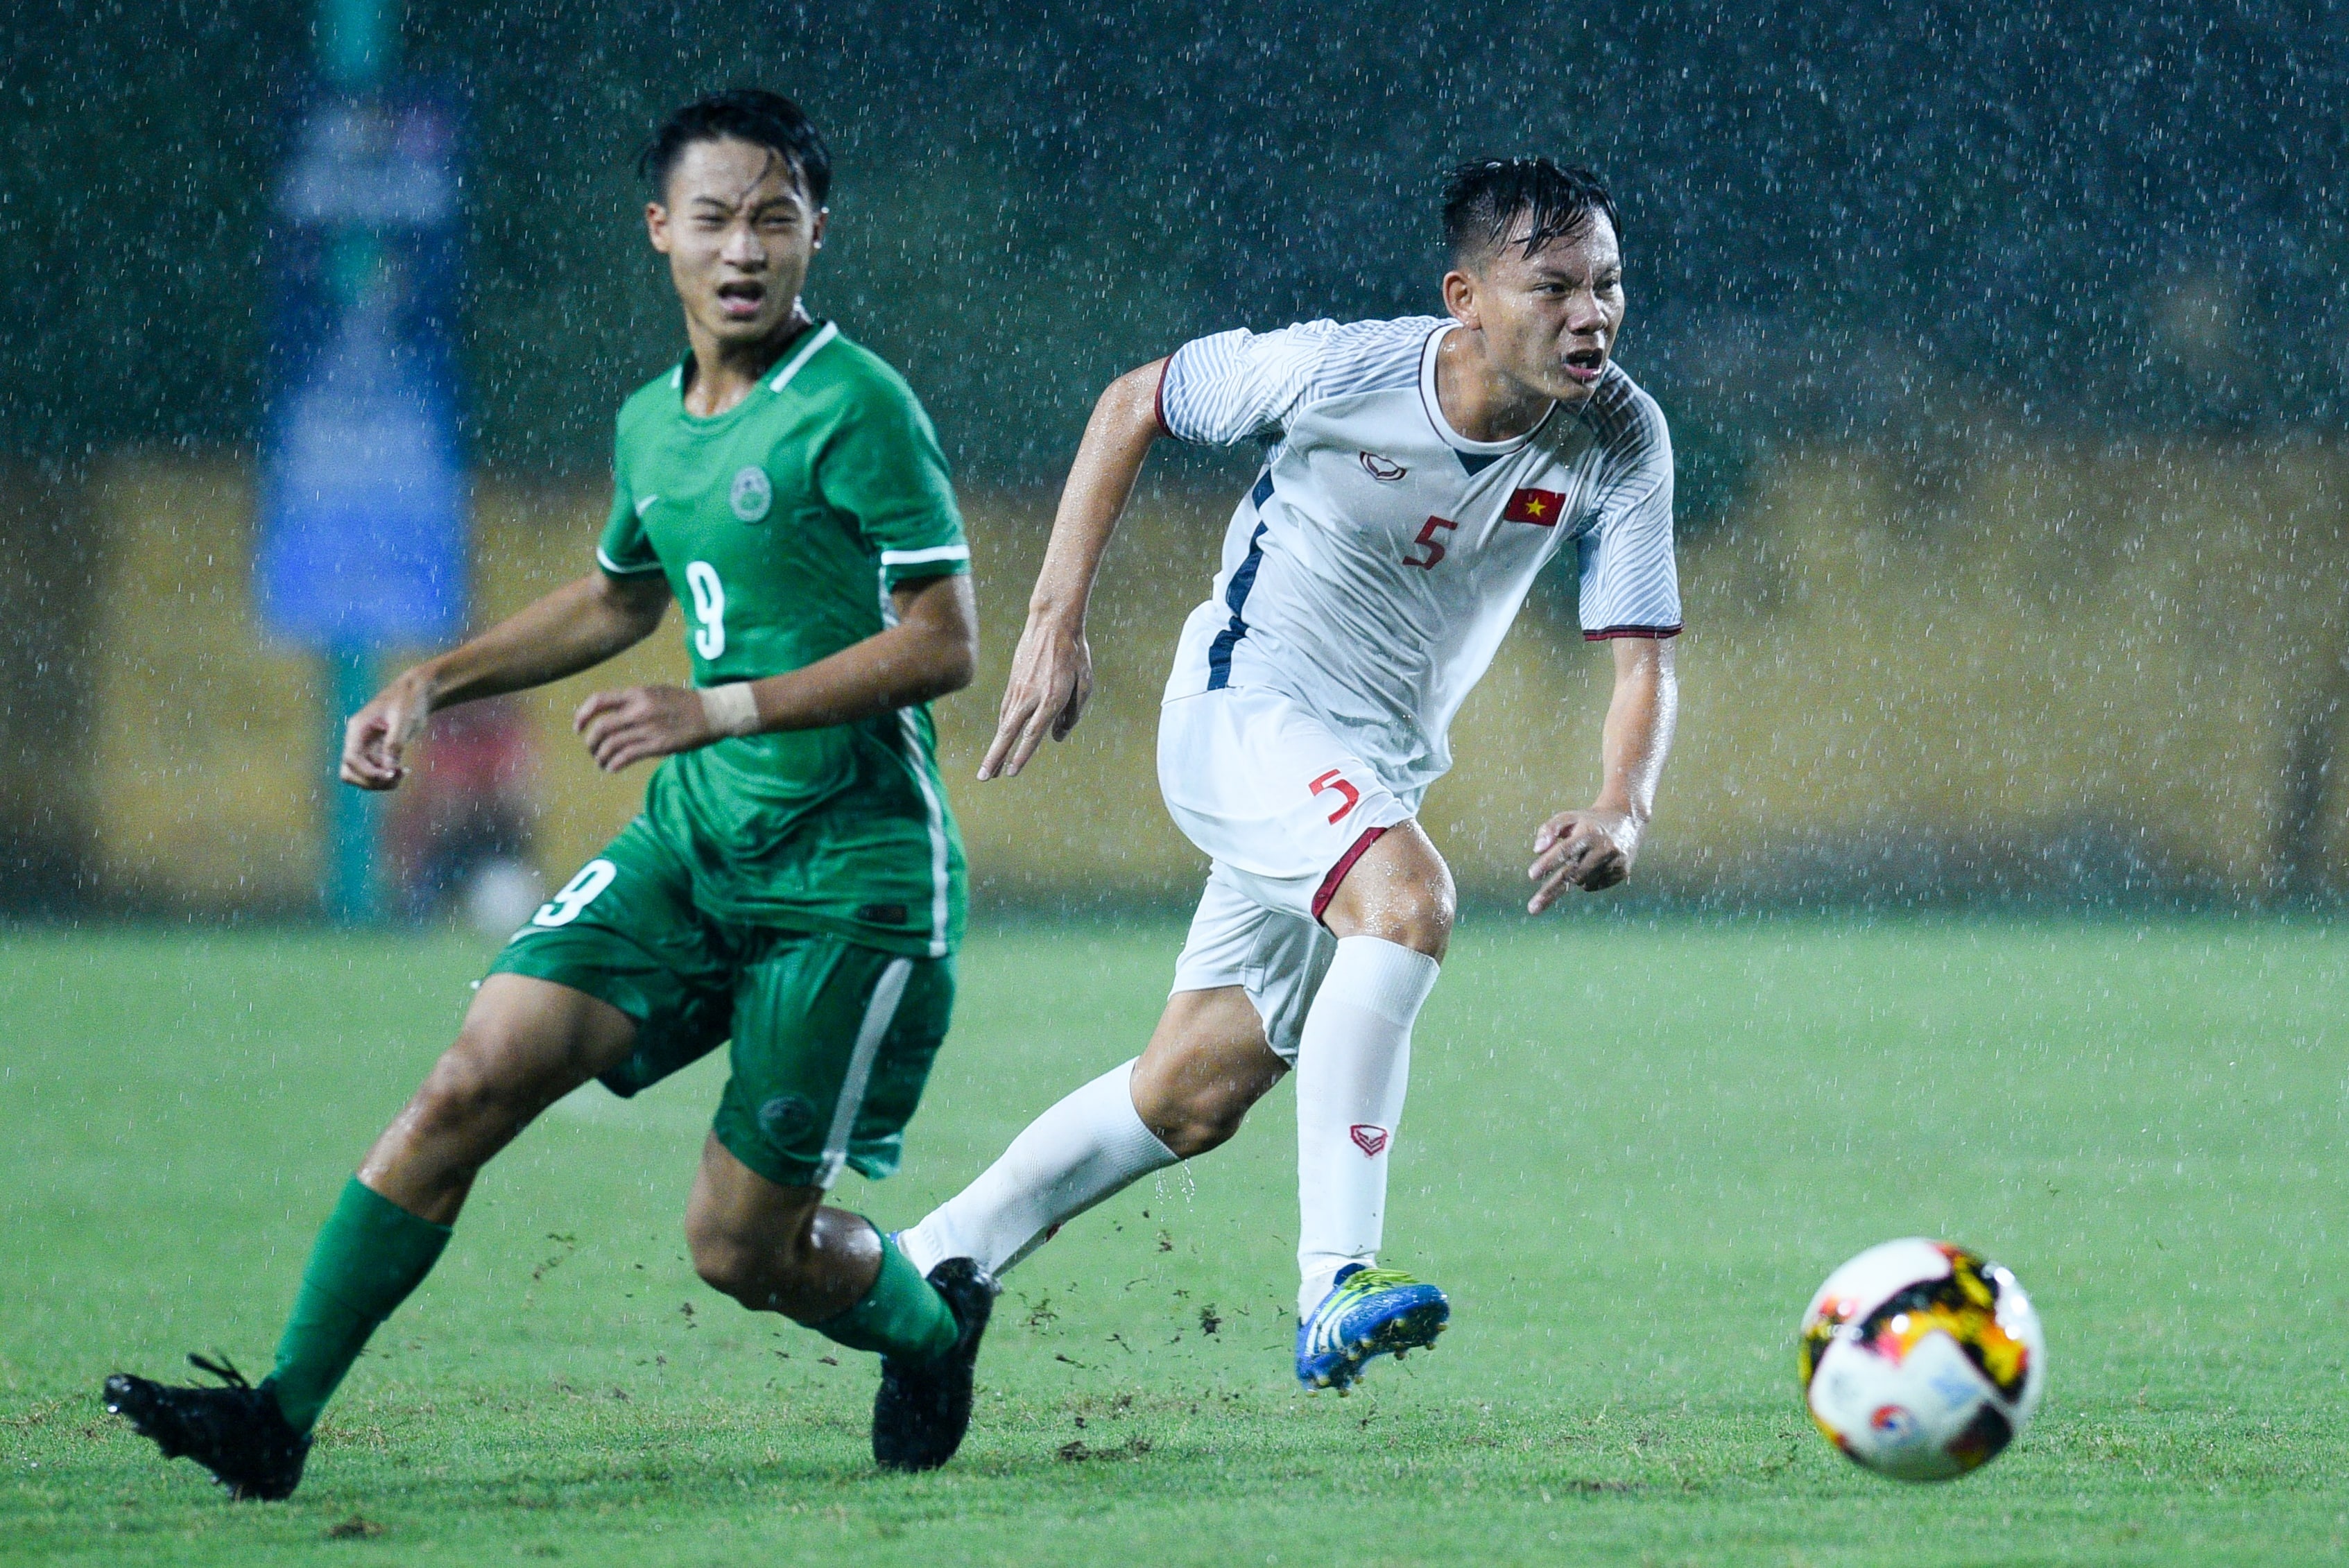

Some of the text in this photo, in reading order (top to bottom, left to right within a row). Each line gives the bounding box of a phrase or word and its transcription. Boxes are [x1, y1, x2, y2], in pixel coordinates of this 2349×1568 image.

[1402, 515, 1458, 570] 5
[686, 561, 725, 660] 9
[1309, 768, 1359, 825] 5
[534, 859, 617, 928] 9
